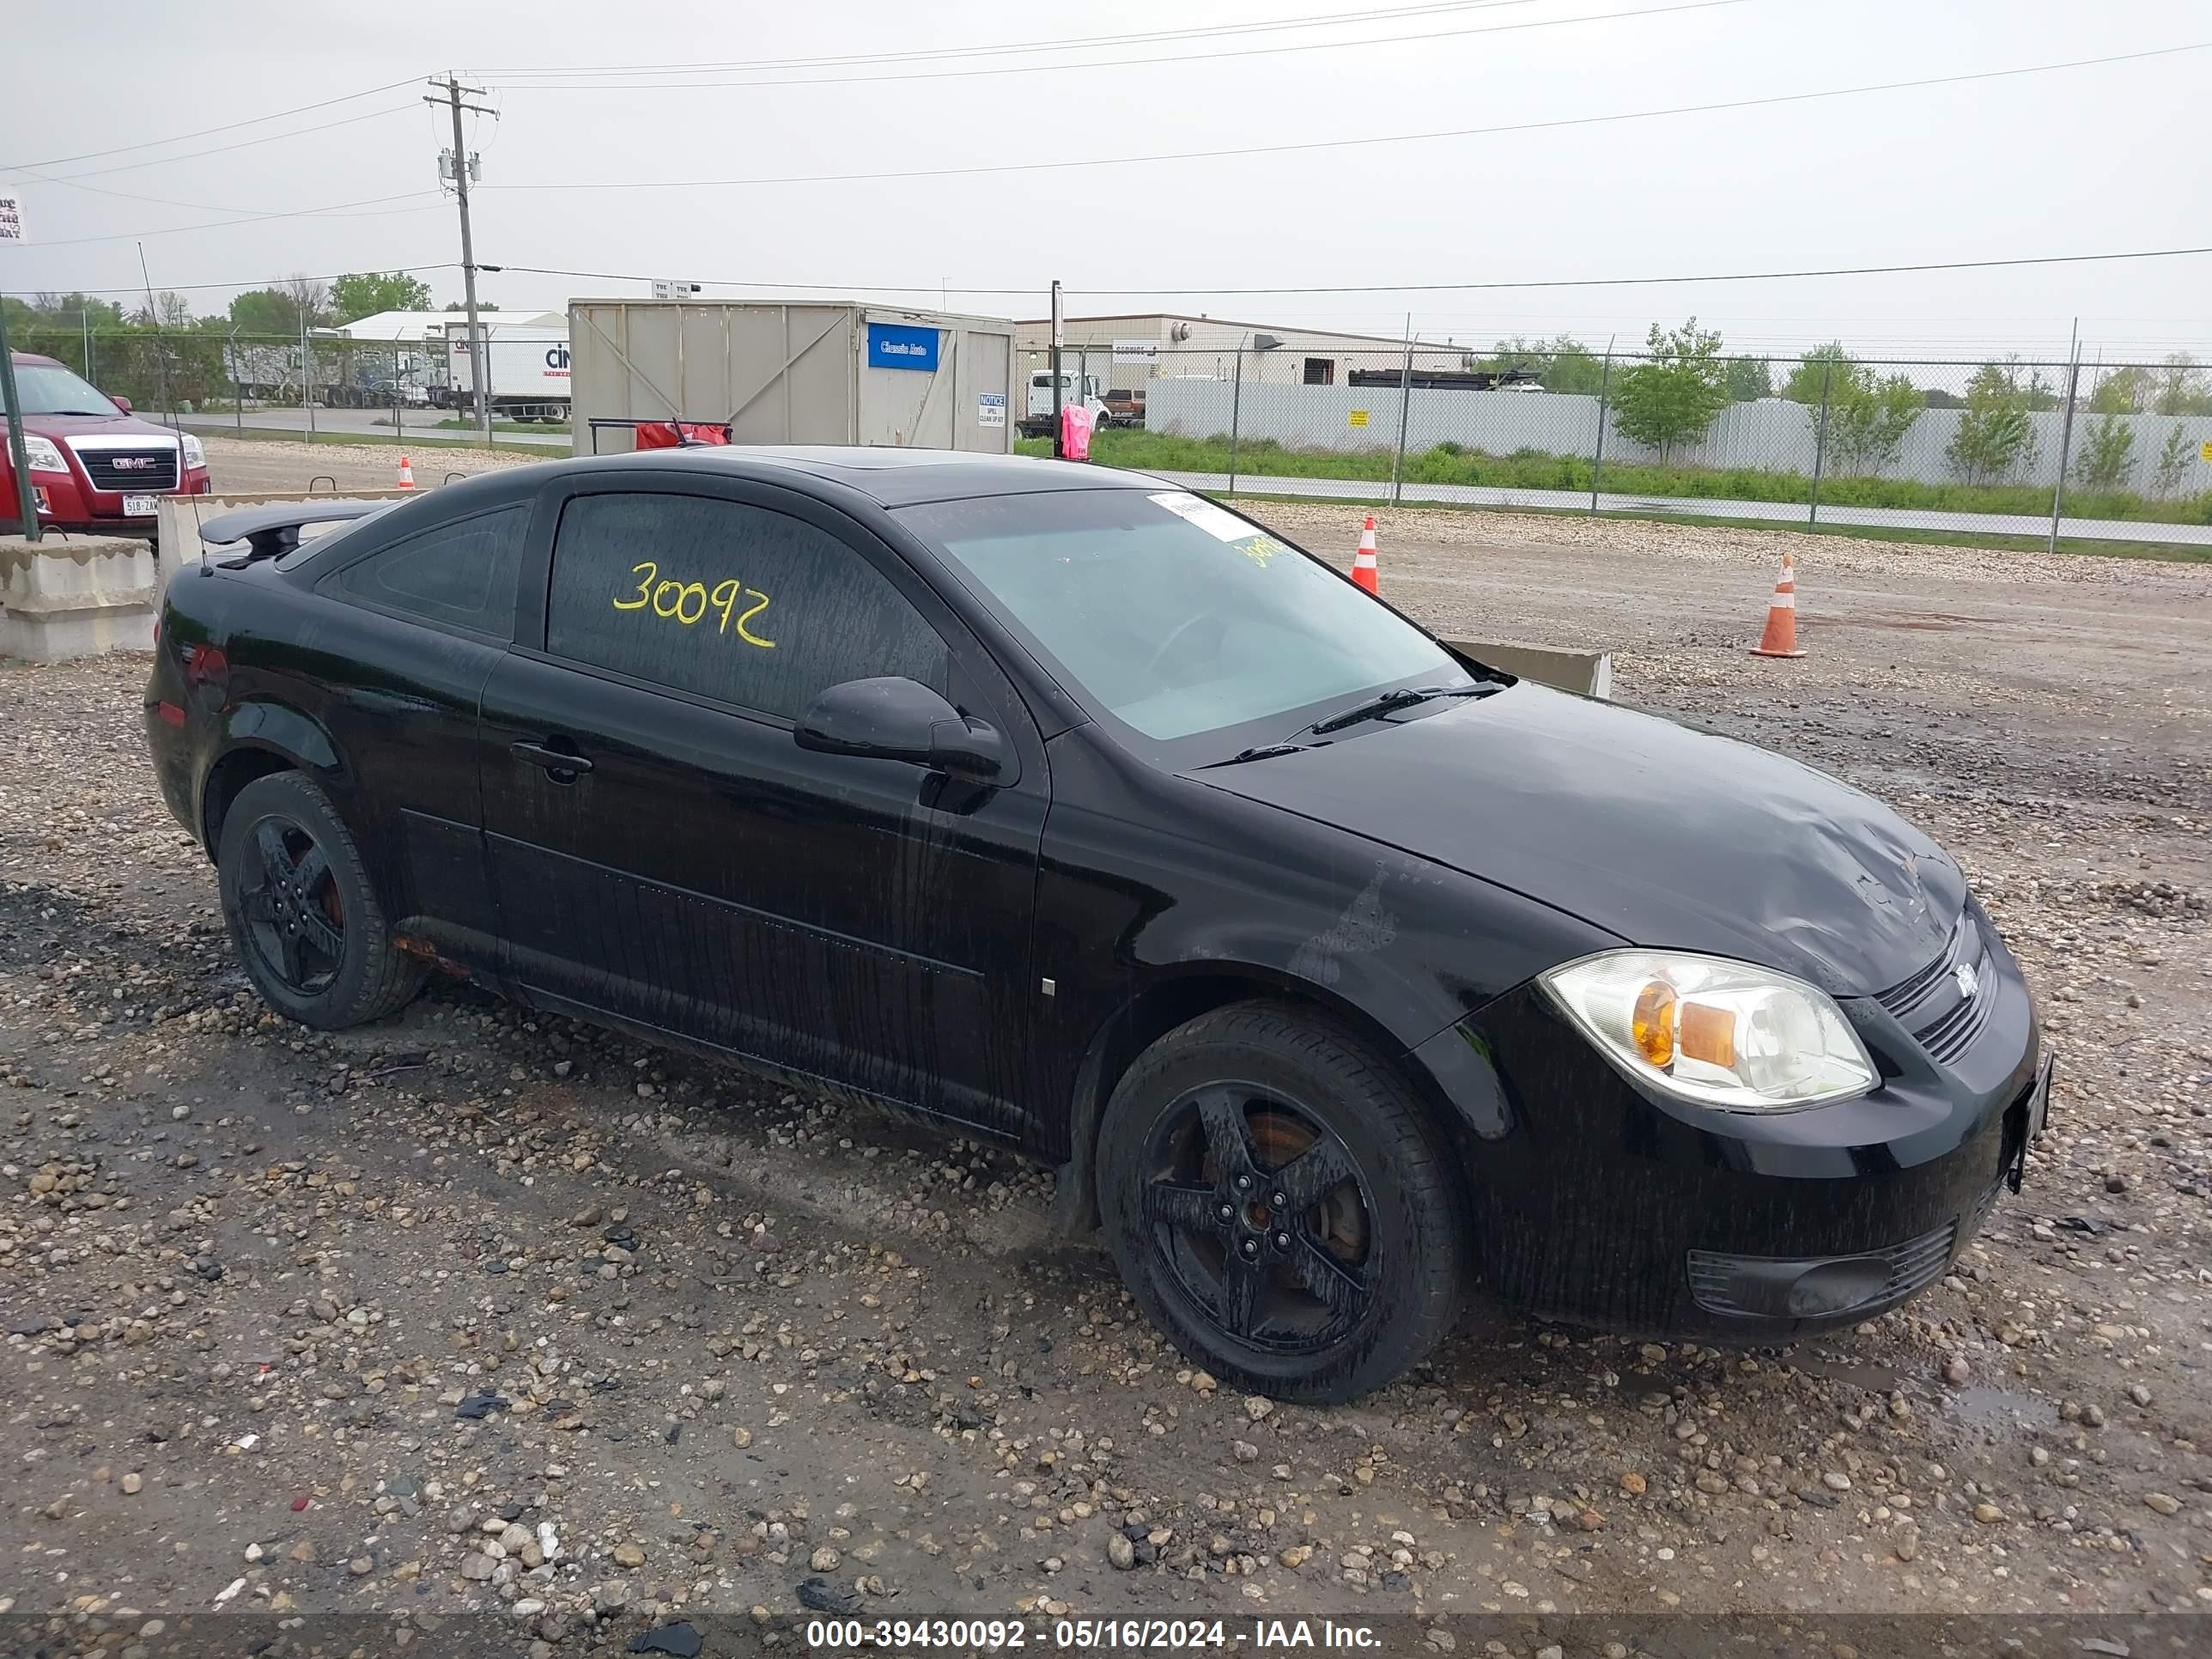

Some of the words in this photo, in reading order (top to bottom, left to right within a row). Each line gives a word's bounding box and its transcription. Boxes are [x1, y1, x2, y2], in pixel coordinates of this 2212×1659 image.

[880, 341, 908, 355] Classic
[909, 343, 927, 356] Auto
[981, 395, 1004, 406] NOTICE
[112, 458, 156, 469] GMC
[613, 562, 775, 647] 30092
